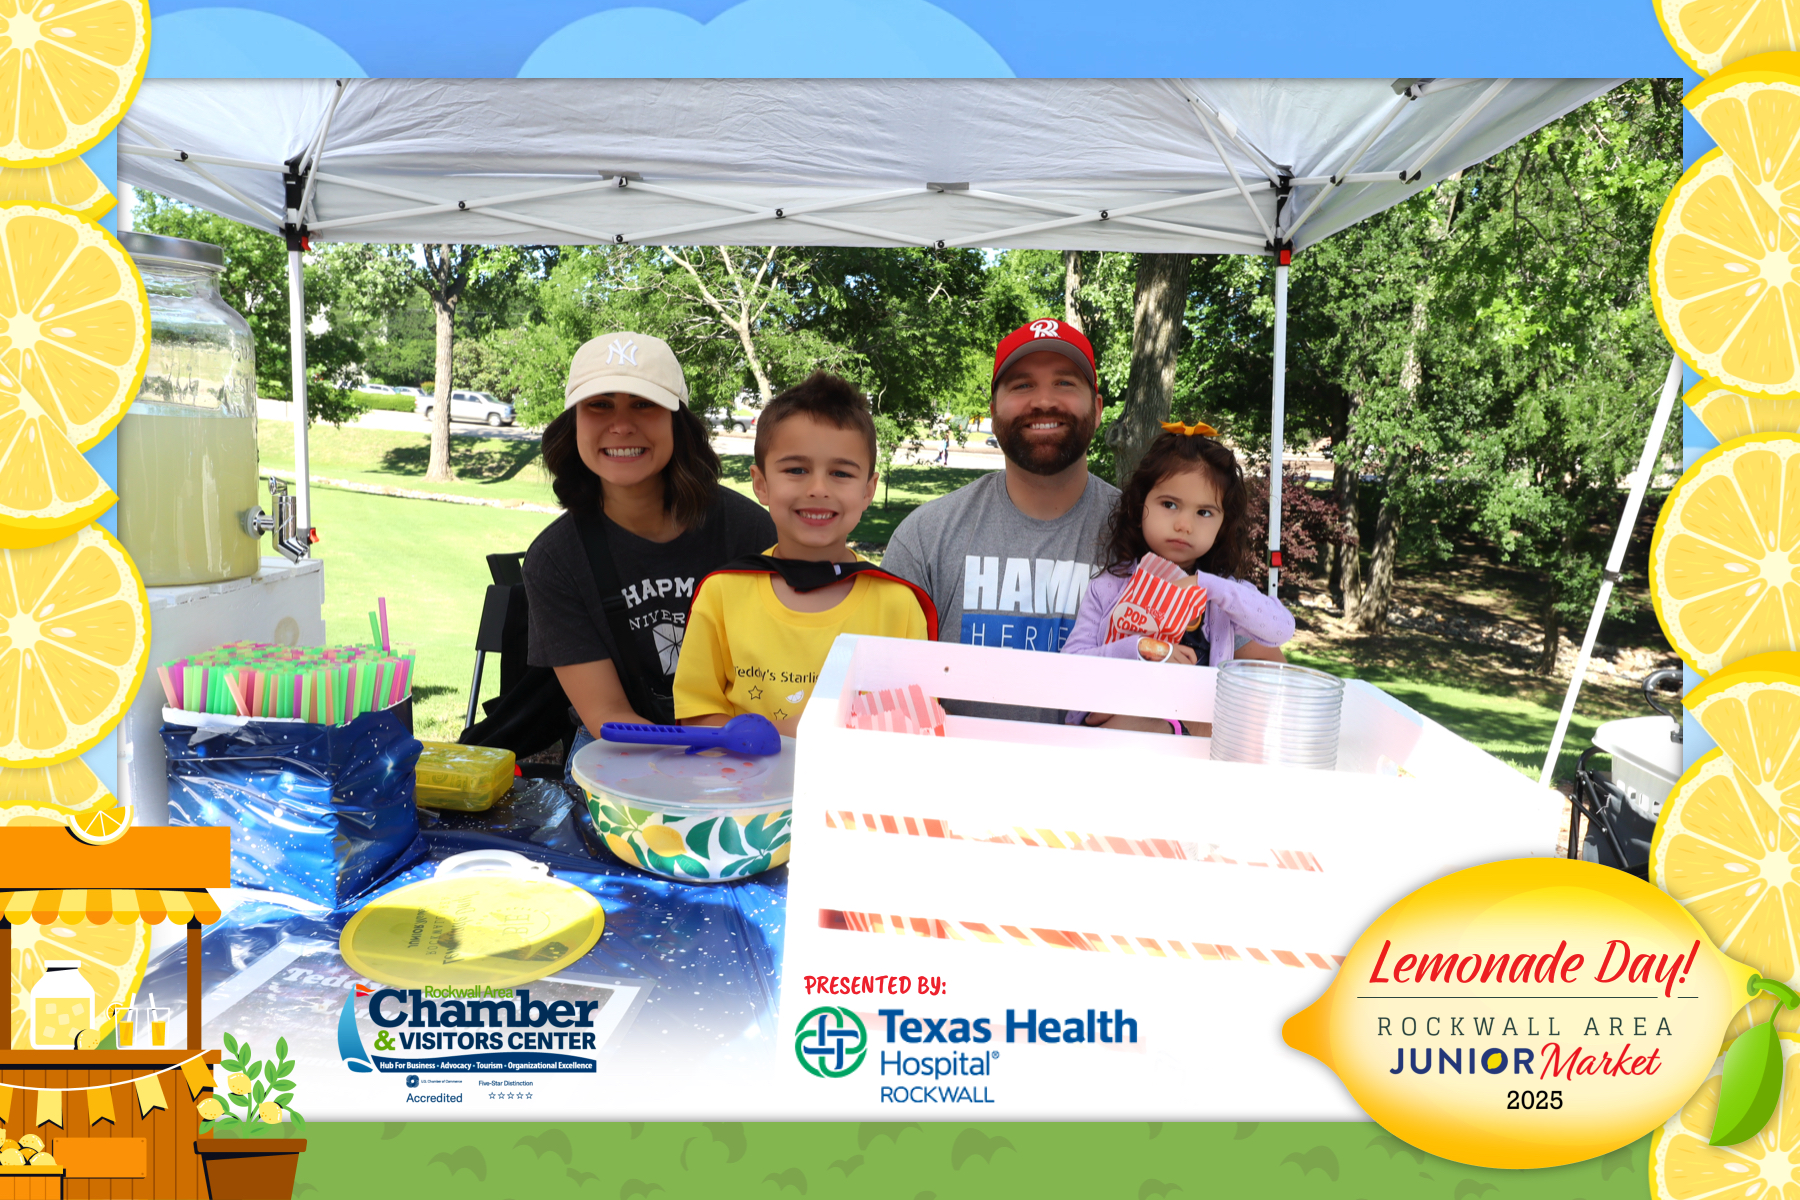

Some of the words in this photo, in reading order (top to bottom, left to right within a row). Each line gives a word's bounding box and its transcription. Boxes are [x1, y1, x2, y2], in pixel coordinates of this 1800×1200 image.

[606, 338, 639, 367] NY
[621, 577, 695, 609] HAPM
[1124, 606, 1148, 626] POP
[734, 665, 776, 682] Teddy's
